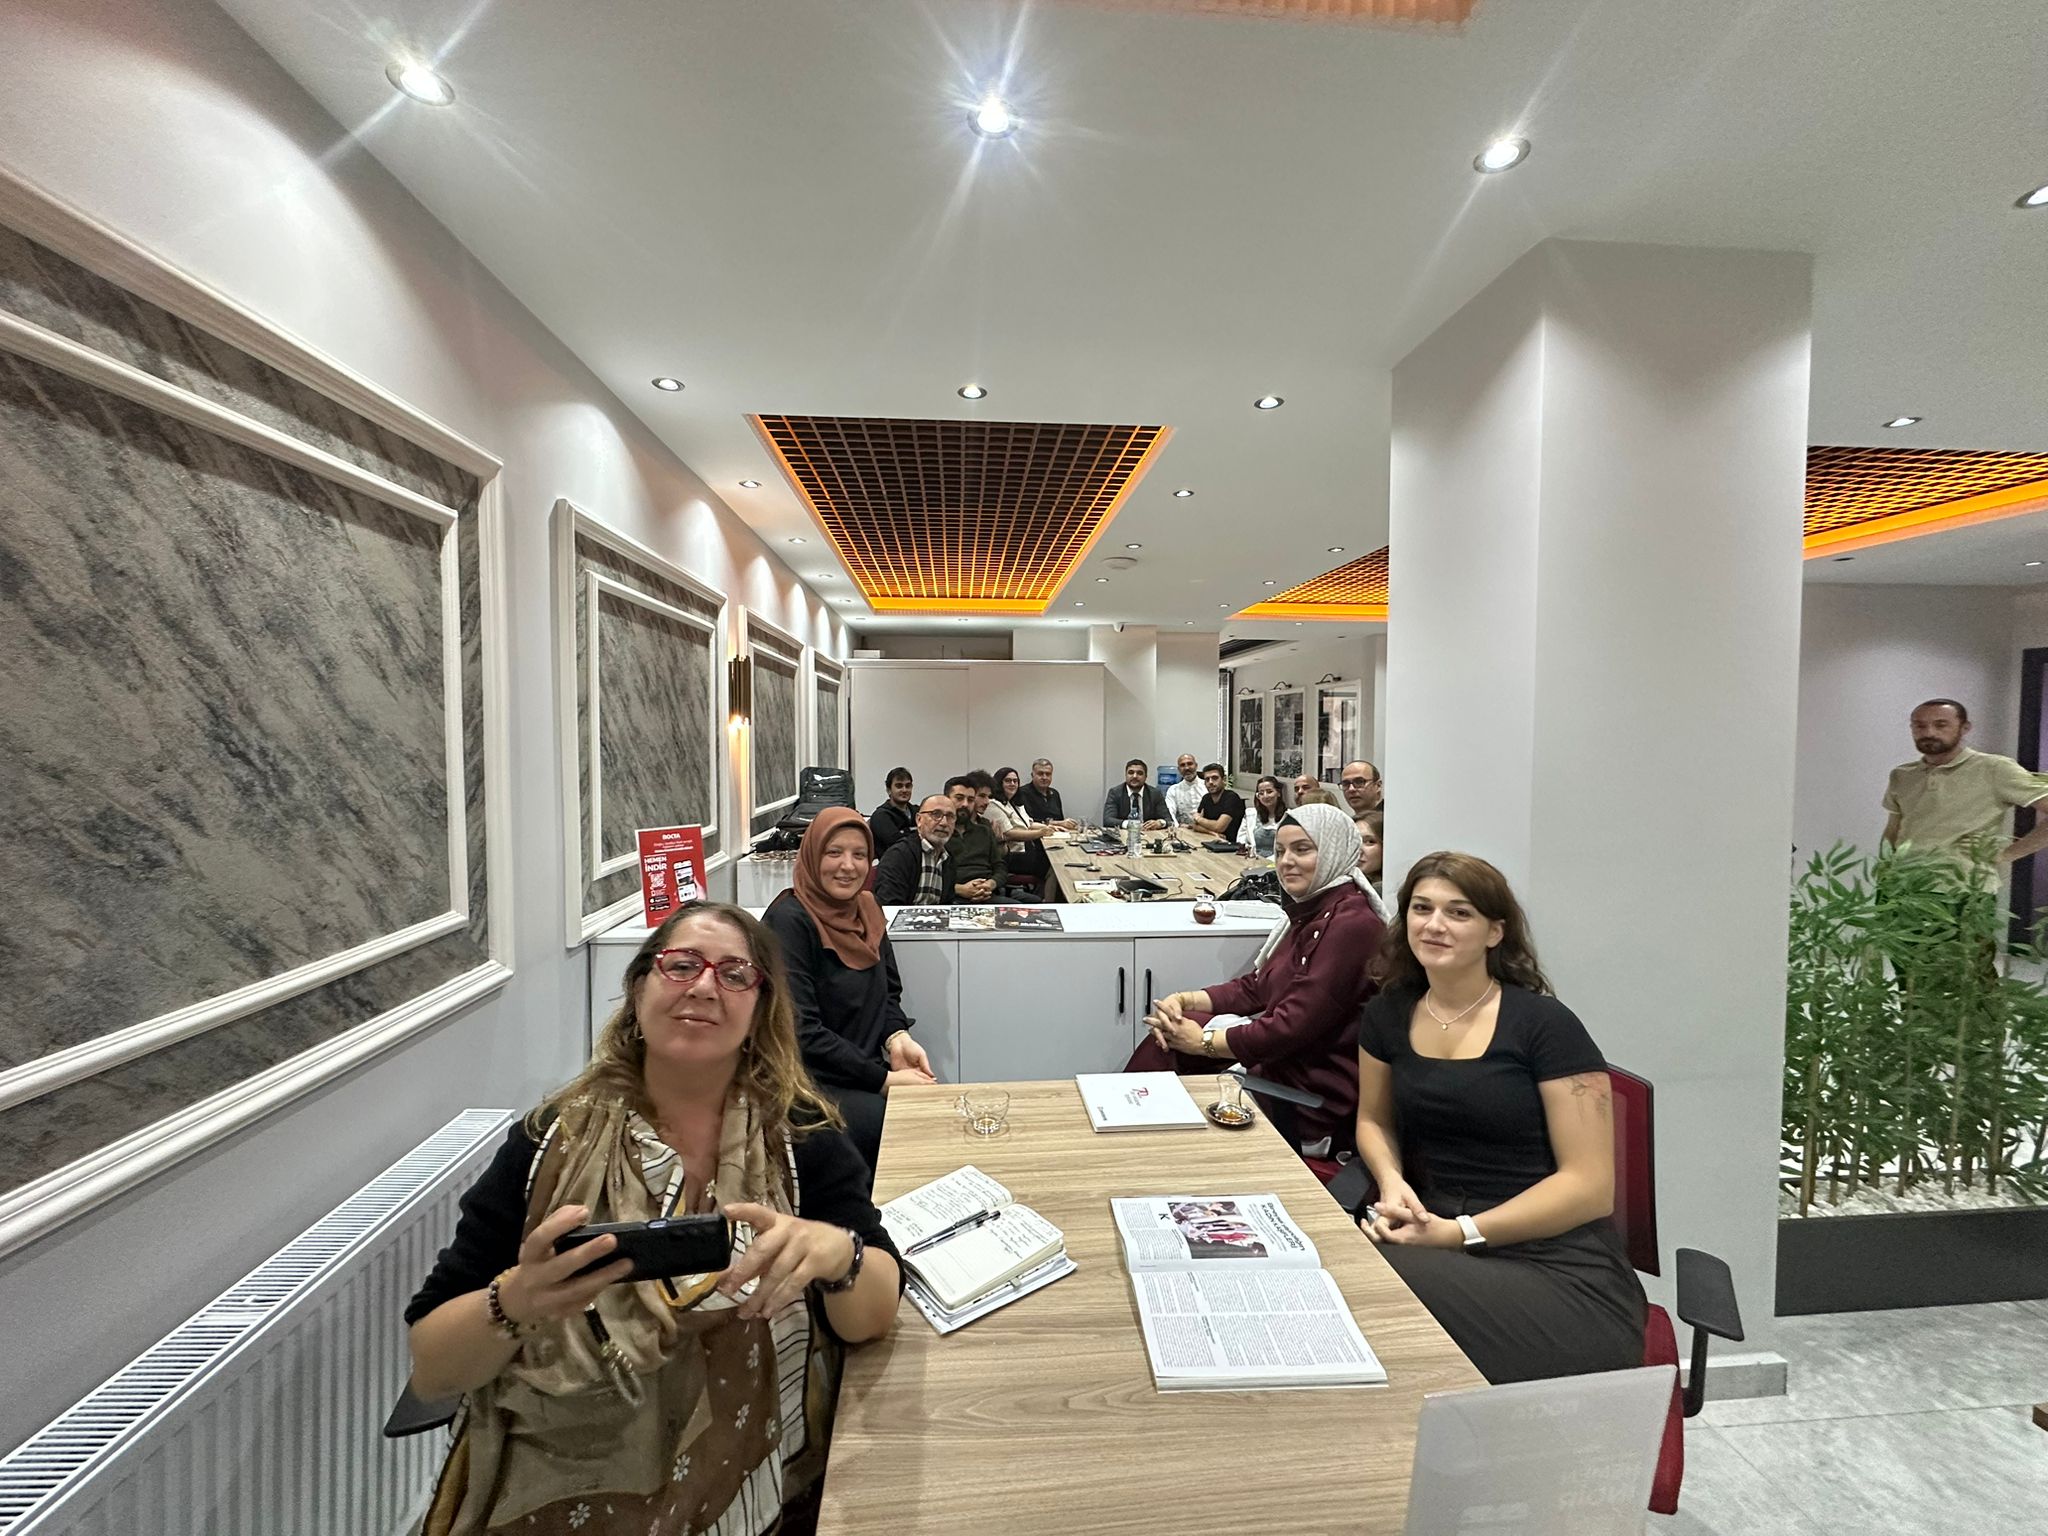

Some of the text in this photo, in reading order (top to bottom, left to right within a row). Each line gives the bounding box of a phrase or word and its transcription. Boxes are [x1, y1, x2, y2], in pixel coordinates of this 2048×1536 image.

[644, 856, 667, 864] HEMEN
[645, 862, 668, 872] İNDİR
[1158, 1212, 1170, 1220] K
